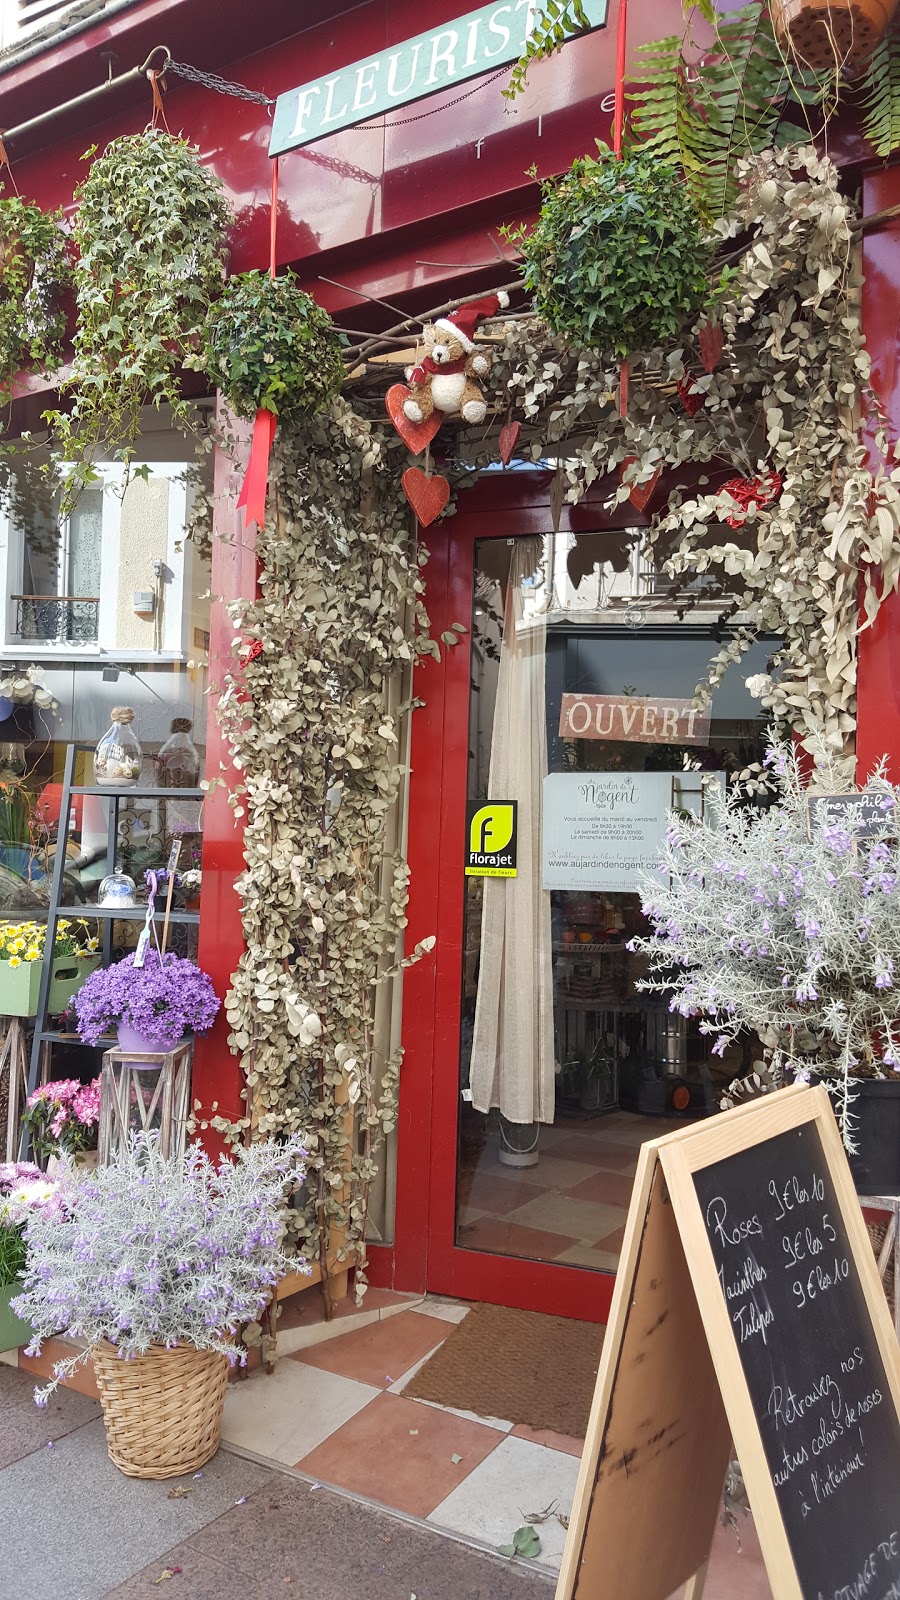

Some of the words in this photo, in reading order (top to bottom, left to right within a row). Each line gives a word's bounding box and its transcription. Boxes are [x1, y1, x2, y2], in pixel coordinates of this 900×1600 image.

[288, 0, 582, 138] FLEURIST
[568, 701, 702, 738] OUVERT
[577, 784, 640, 811] Nogent
[596, 780, 619, 794] jardin
[469, 852, 513, 867] florajet
[706, 1196, 763, 1248] Roses
[793, 1175, 810, 1204] les
[812, 1173, 825, 1202] 10
[718, 1256, 768, 1301] Jacinthes
[806, 1227, 823, 1256] les
[822, 1213, 837, 1242] 5
[733, 1301, 775, 1346] Tulipes
[816, 1265, 832, 1291] les
[834, 1257, 849, 1285] 10
[767, 1374, 842, 1432] Retrouvez
[840, 1346, 864, 1374] nos
[773, 1444, 809, 1487] autres
[844, 1402, 858, 1429] de
[857, 1388, 883, 1417] roses
[798, 1490, 812, 1517] à
